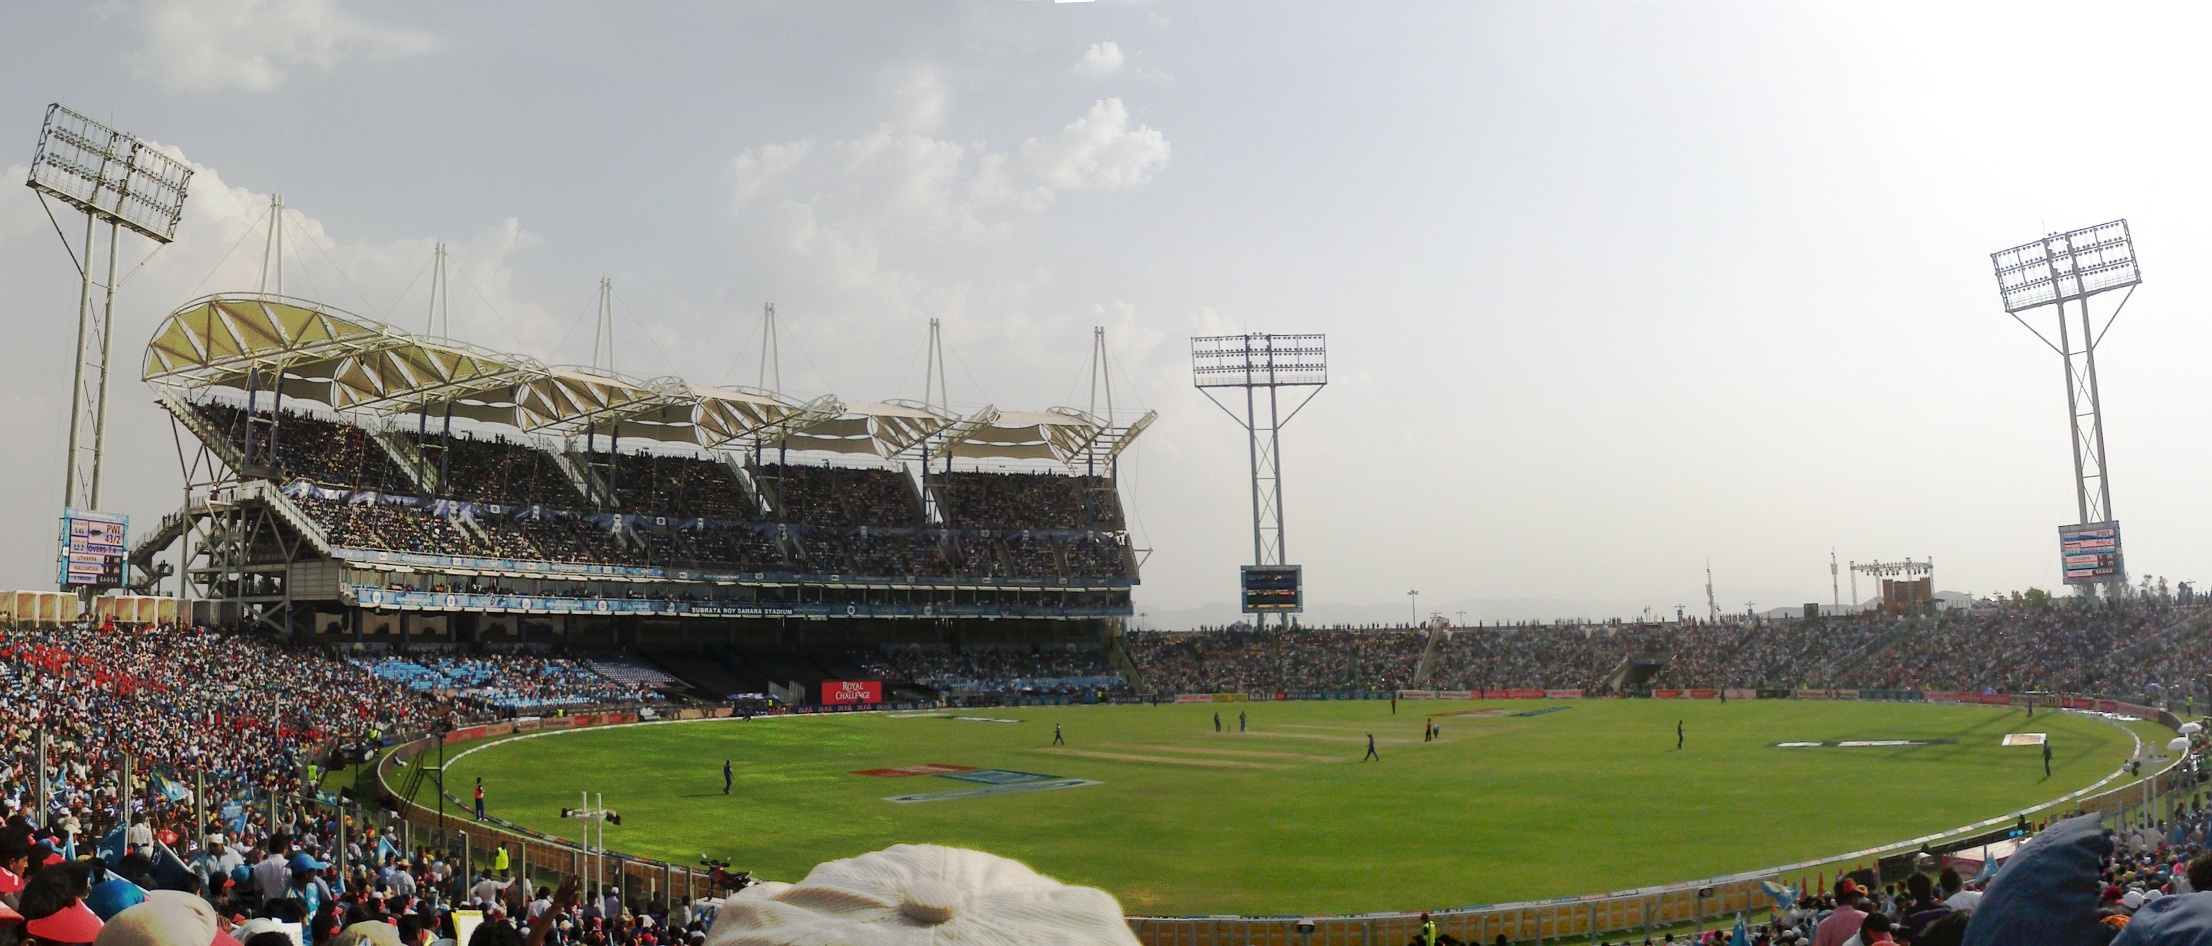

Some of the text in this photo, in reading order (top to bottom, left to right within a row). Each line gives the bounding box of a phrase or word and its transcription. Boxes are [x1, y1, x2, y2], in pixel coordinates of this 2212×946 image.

[106, 524, 120, 534] PWI
[104, 534, 120, 544] 43/2
[842, 682, 863, 691] ROYAL
[836, 691, 870, 700] CHALLENGE
